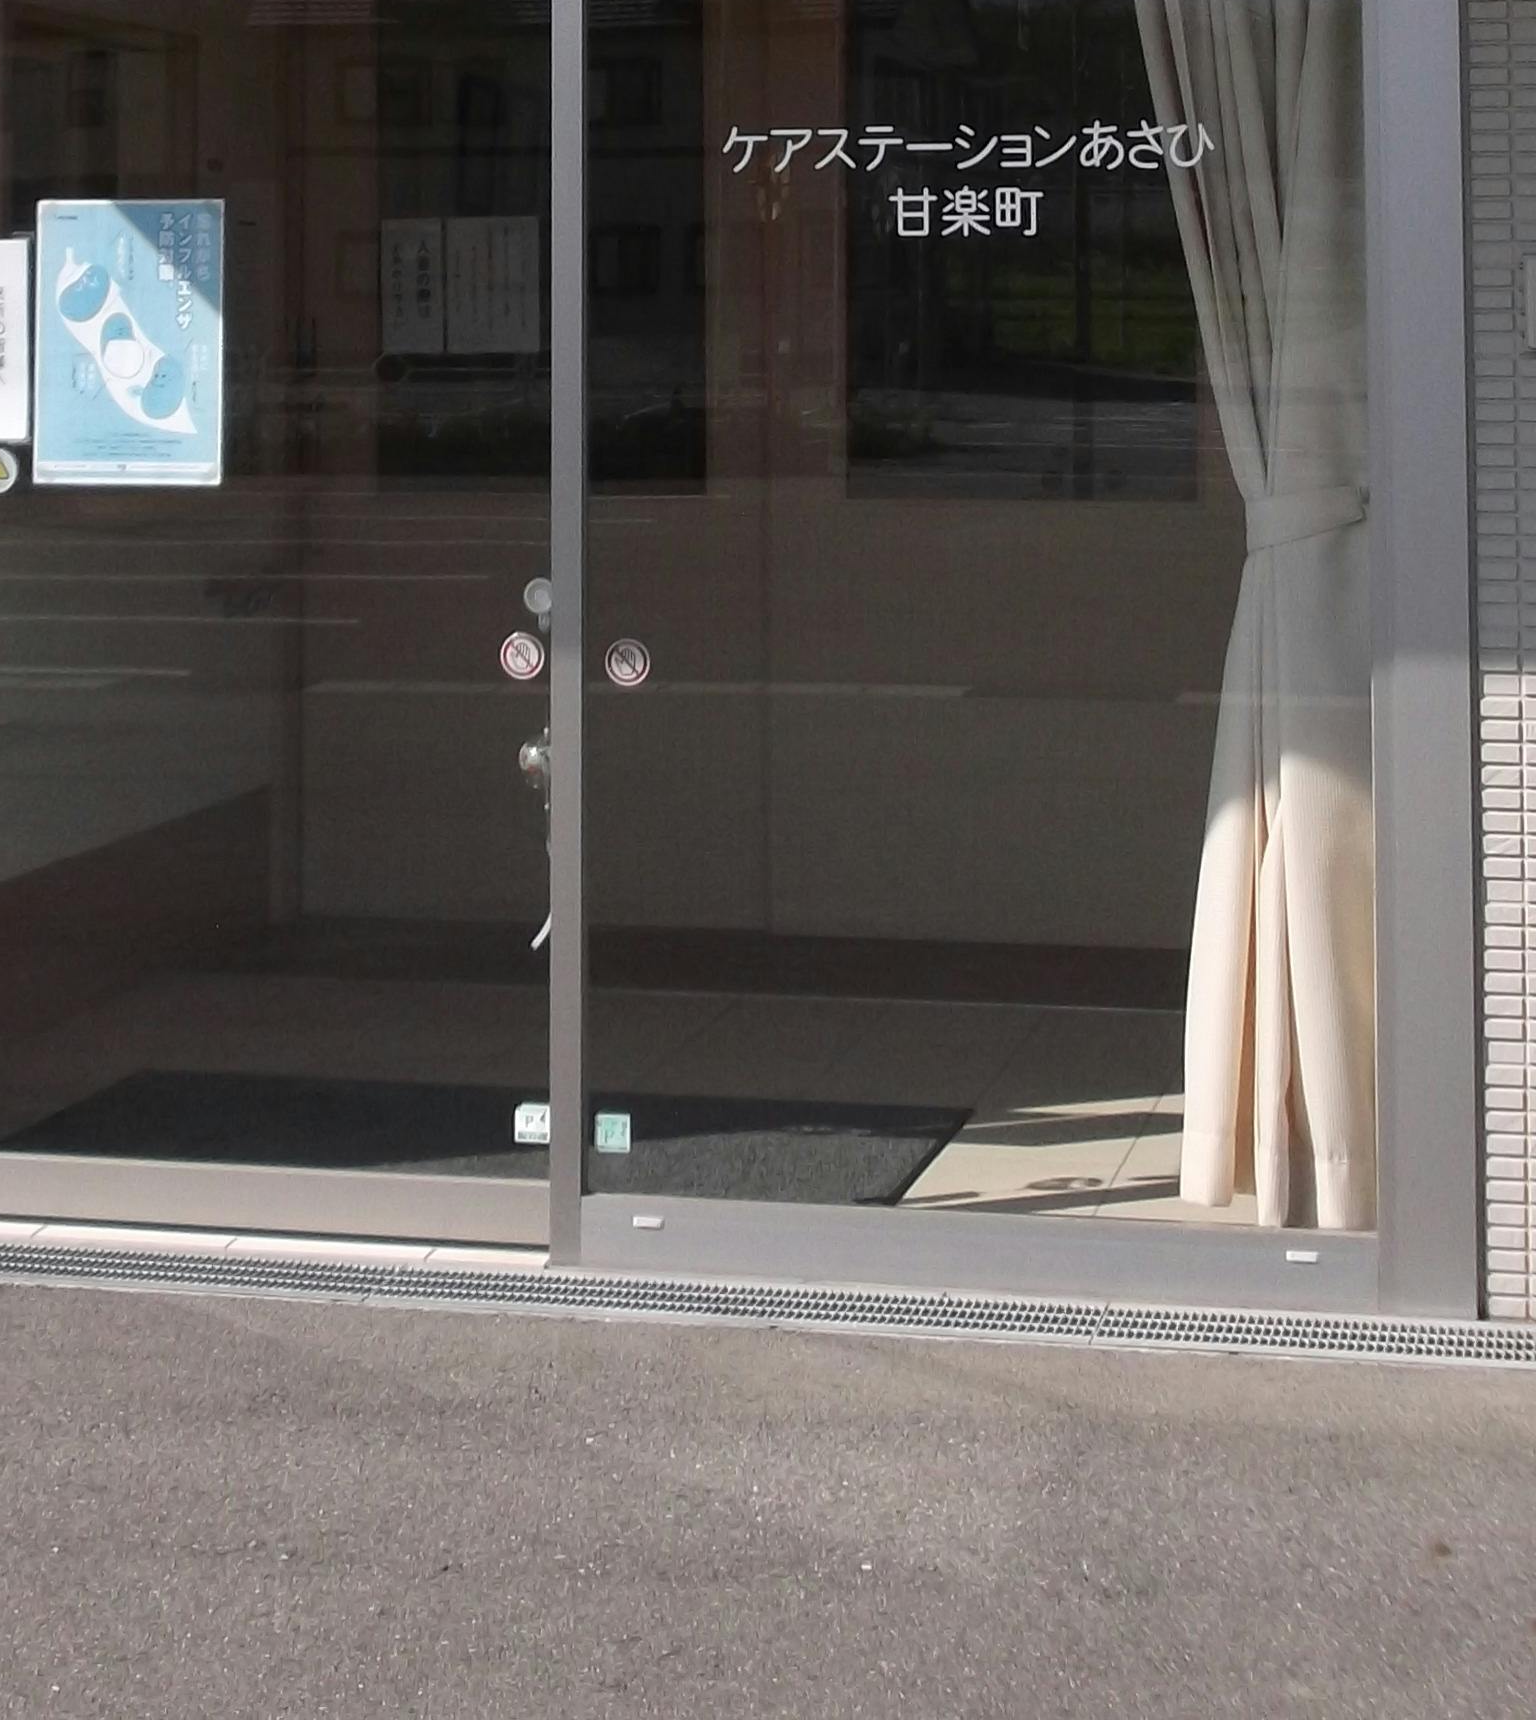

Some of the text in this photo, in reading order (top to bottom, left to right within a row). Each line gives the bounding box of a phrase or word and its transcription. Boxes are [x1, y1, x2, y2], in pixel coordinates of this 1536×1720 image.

[721, 119, 1215, 174] ケアステーションあさひ
[888, 185, 1045, 238] 甘楽町
[176, 214, 193, 330] インフルエンザ
